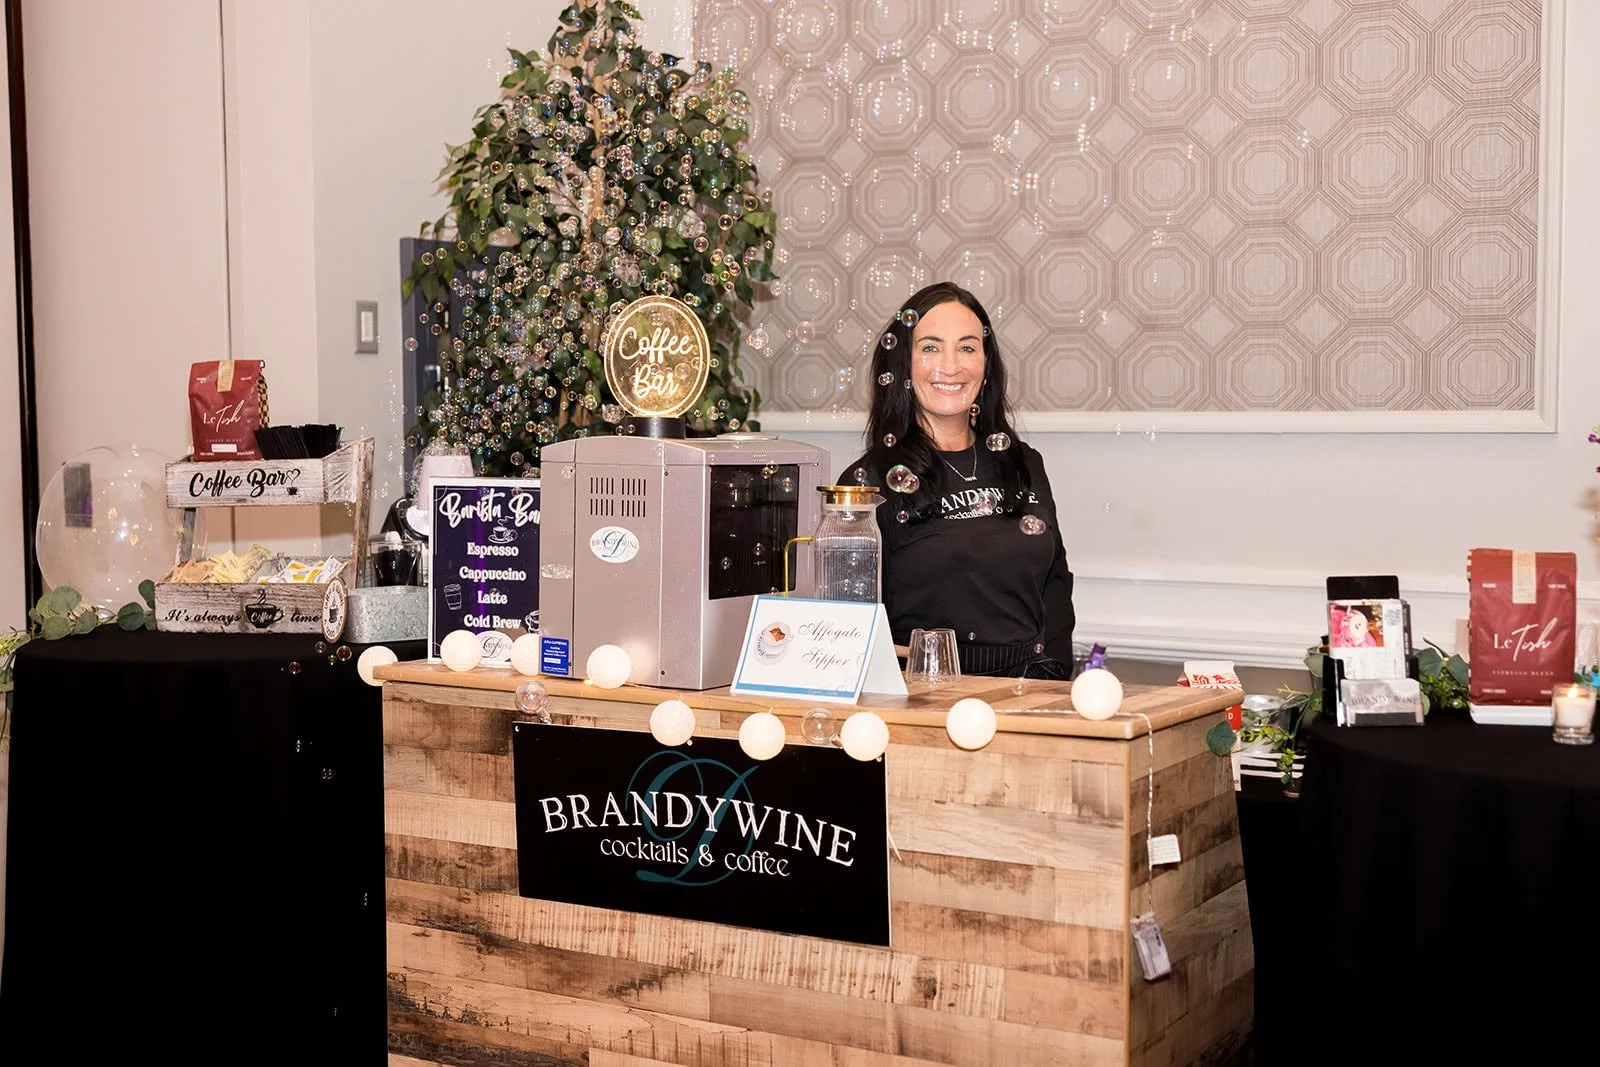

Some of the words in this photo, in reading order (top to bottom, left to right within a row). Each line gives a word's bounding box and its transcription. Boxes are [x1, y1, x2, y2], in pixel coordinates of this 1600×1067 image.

[619, 326, 694, 364] Coffee
[634, 364, 680, 398] Bar
[189, 470, 242, 497] Coffee
[246, 468, 288, 498] Bar
[439, 488, 506, 528] Barista
[467, 542, 519, 558] Espresso
[459, 566, 526, 582] Cappuccino
[478, 591, 508, 604] Latte
[165, 609, 190, 622] It's
[194, 610, 242, 626] always
[251, 612, 274, 622] Coffee
[290, 612, 322, 622] time
[464, 614, 490, 628] Cold
[492, 615, 521, 629] Brew
[799, 620, 862, 642] Affogato
[1512, 618, 1558, 662] Tish
[801, 647, 850, 670] Sipper
[539, 792, 857, 866] BRANDYWINE
[600, 836, 689, 865] cocktails
[698, 844, 715, 866] &
[724, 850, 790, 878] coffee
